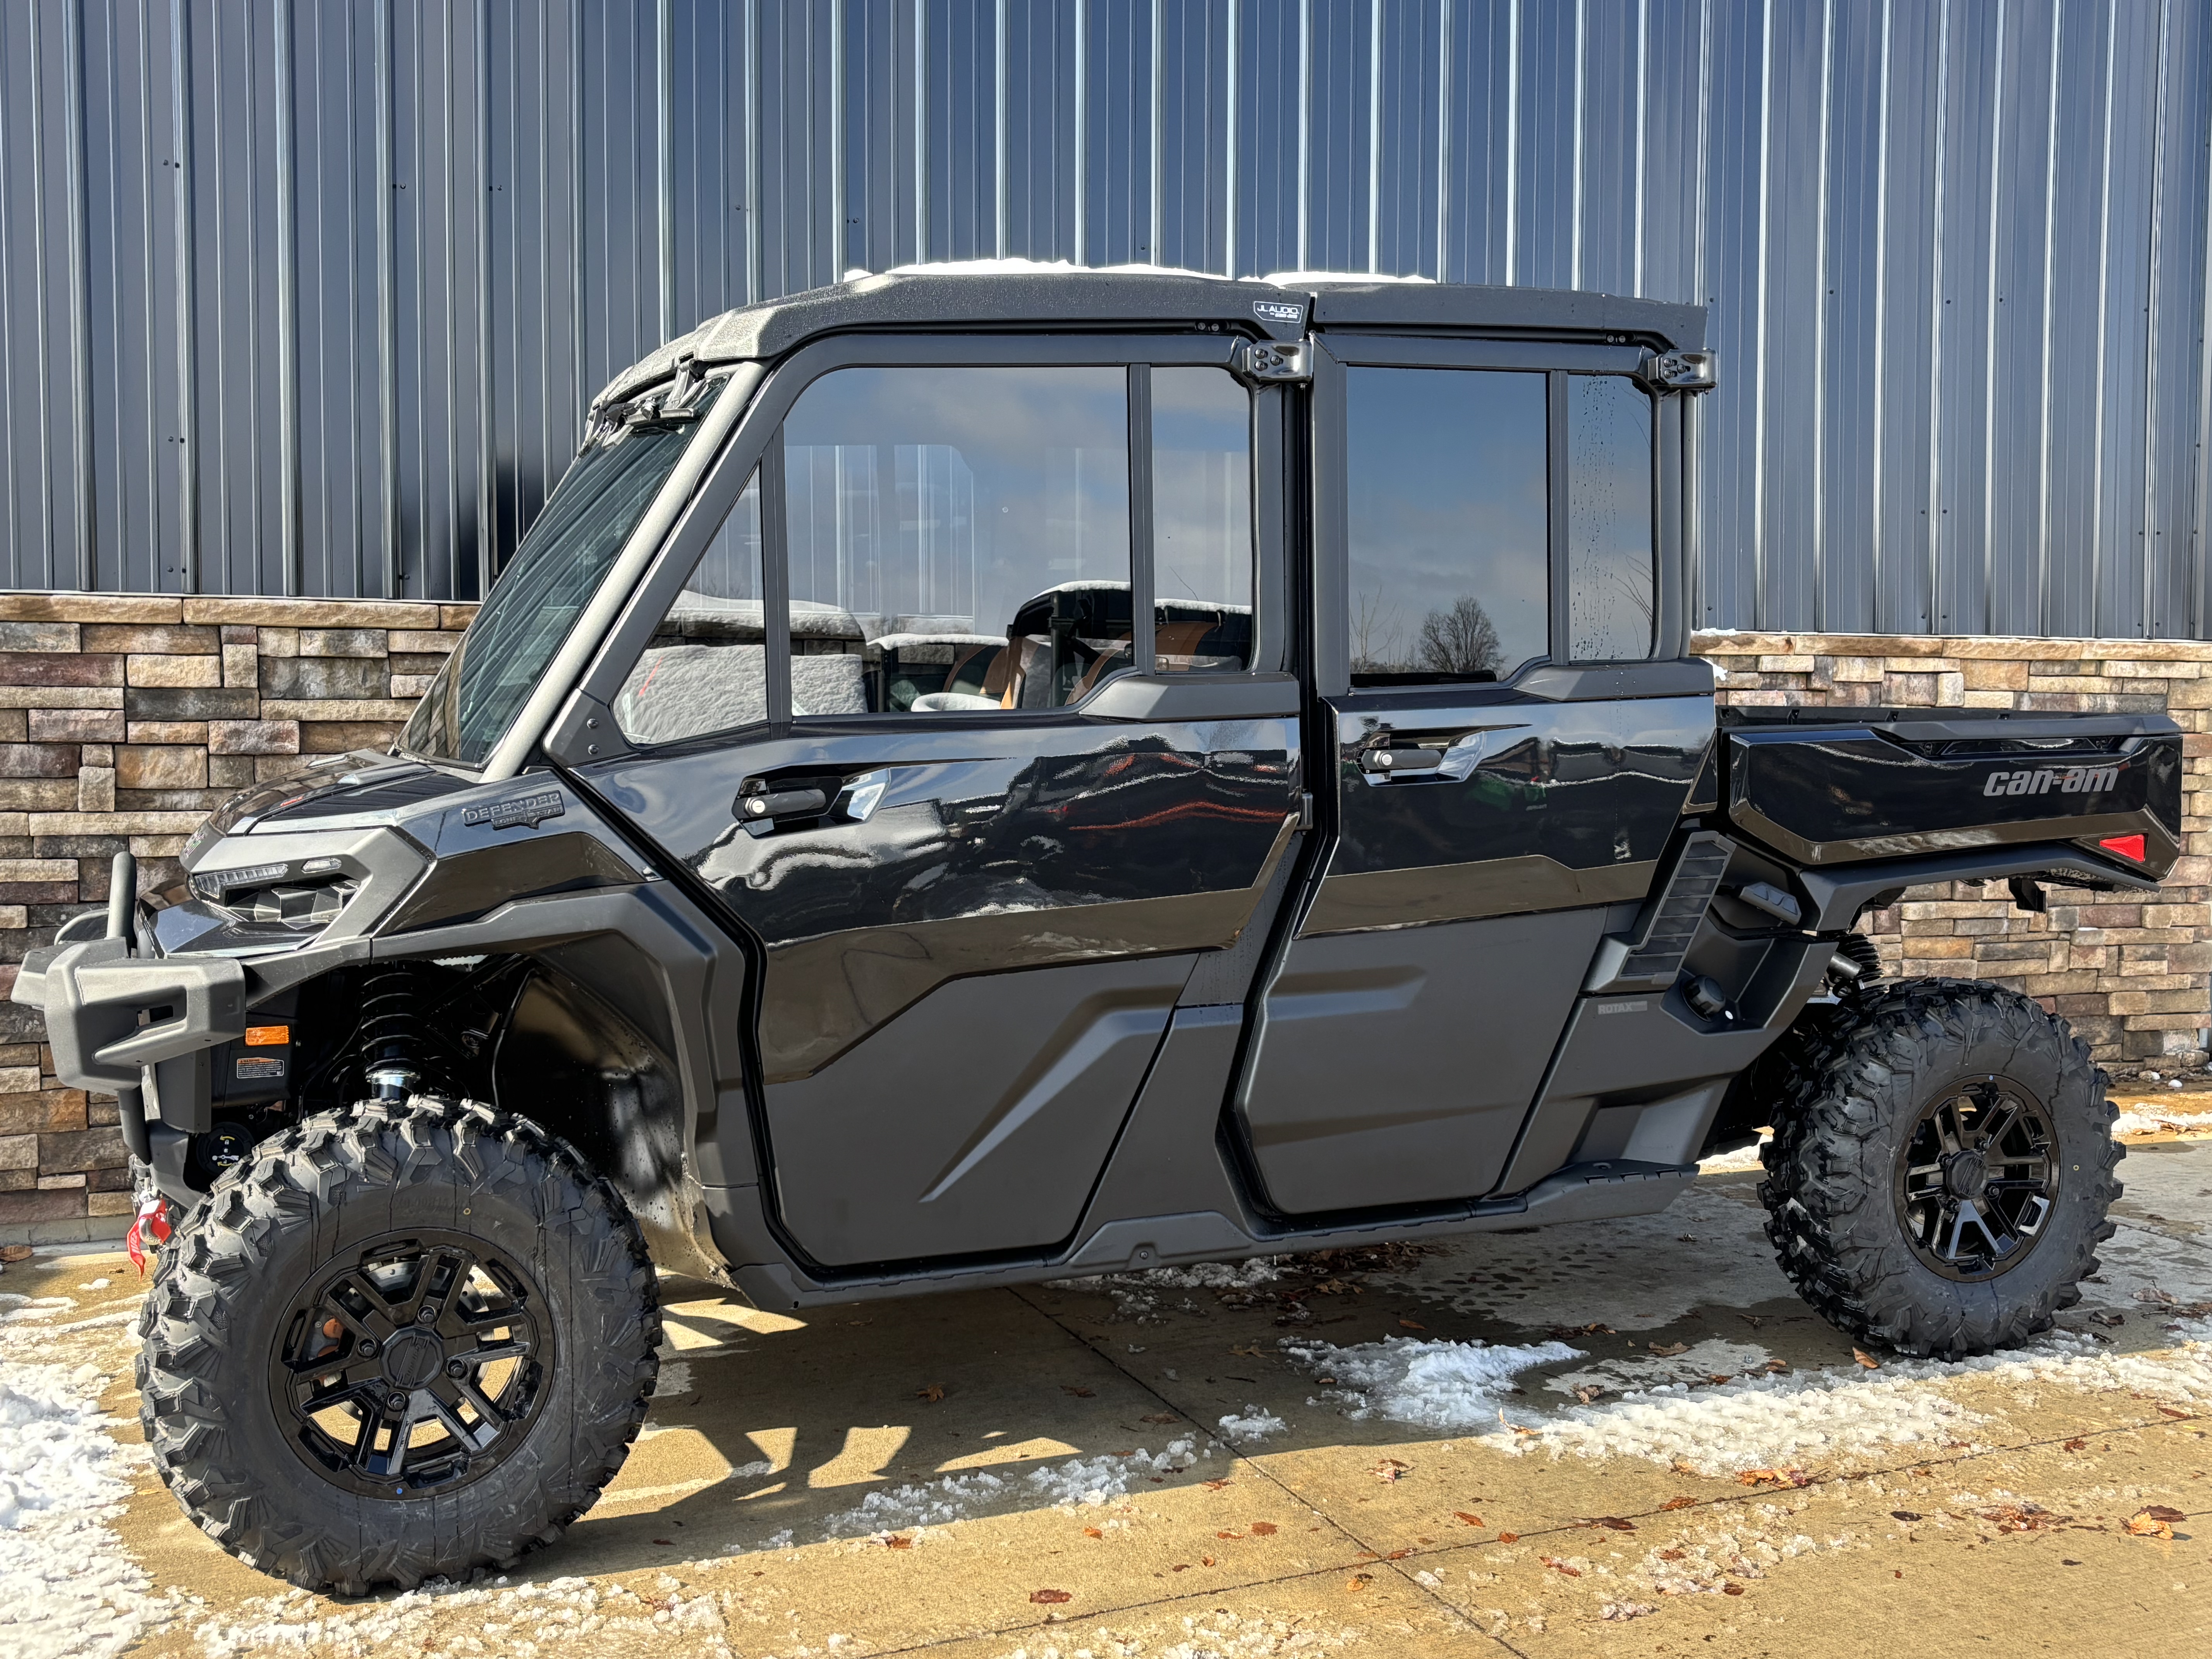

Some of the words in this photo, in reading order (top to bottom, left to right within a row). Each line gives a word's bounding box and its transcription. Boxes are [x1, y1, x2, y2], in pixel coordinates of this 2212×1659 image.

[1269, 305, 1298, 314] AUDIO
[1983, 768, 2119, 797] can-am
[465, 793, 560, 821] DEFENDER
[1598, 1003, 1633, 1015] ROTAX
